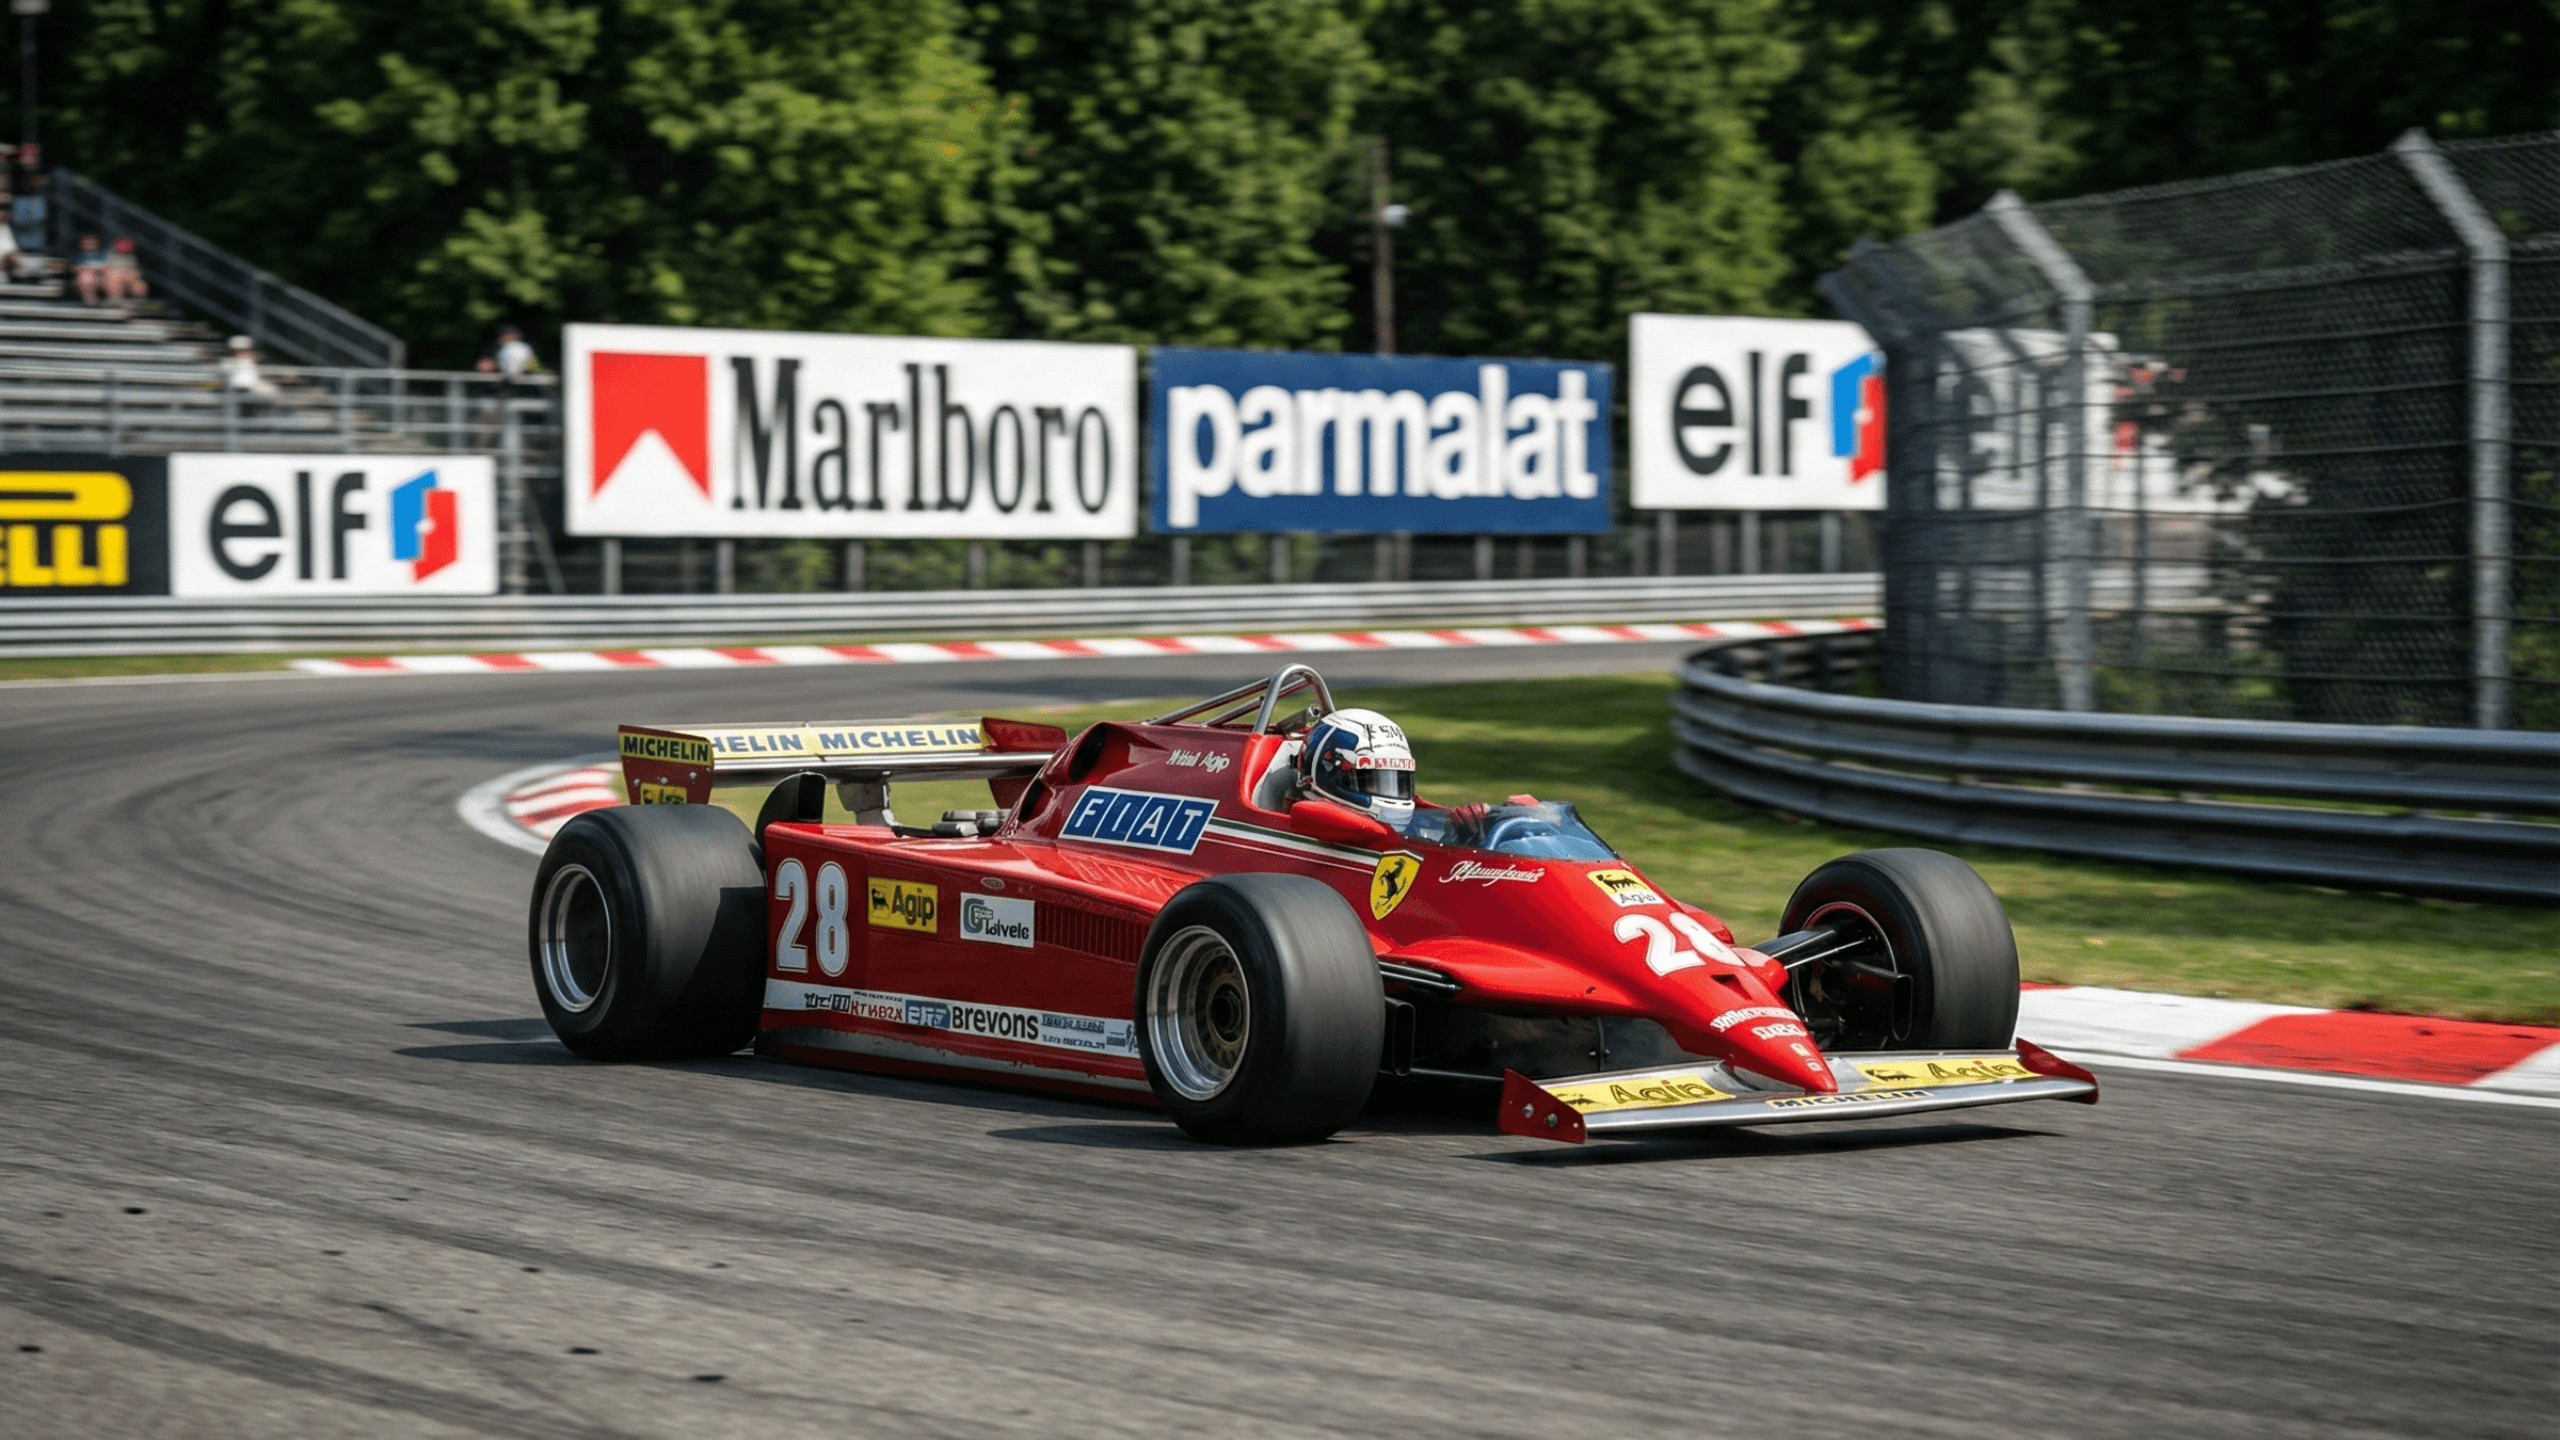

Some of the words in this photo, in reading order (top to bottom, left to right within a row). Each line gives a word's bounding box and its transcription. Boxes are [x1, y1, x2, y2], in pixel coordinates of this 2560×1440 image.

[730, 356, 1112, 513] Marlboro
[1673, 350, 1813, 476] elf
[1166, 363, 1598, 528] parmalat
[208, 471, 368, 581] elf
[623, 735, 710, 763] MICHELIN
[819, 727, 982, 751] MICHELIN
[1074, 798, 1204, 841] FIAT
[775, 857, 849, 978] 28
[891, 884, 935, 927] Agip
[952, 1006, 1039, 1040] Brevons
[1609, 1079, 1715, 1104] Agip
[1927, 1061, 2028, 1081] Agip
[1773, 1090, 1927, 1108] MICHELIN
